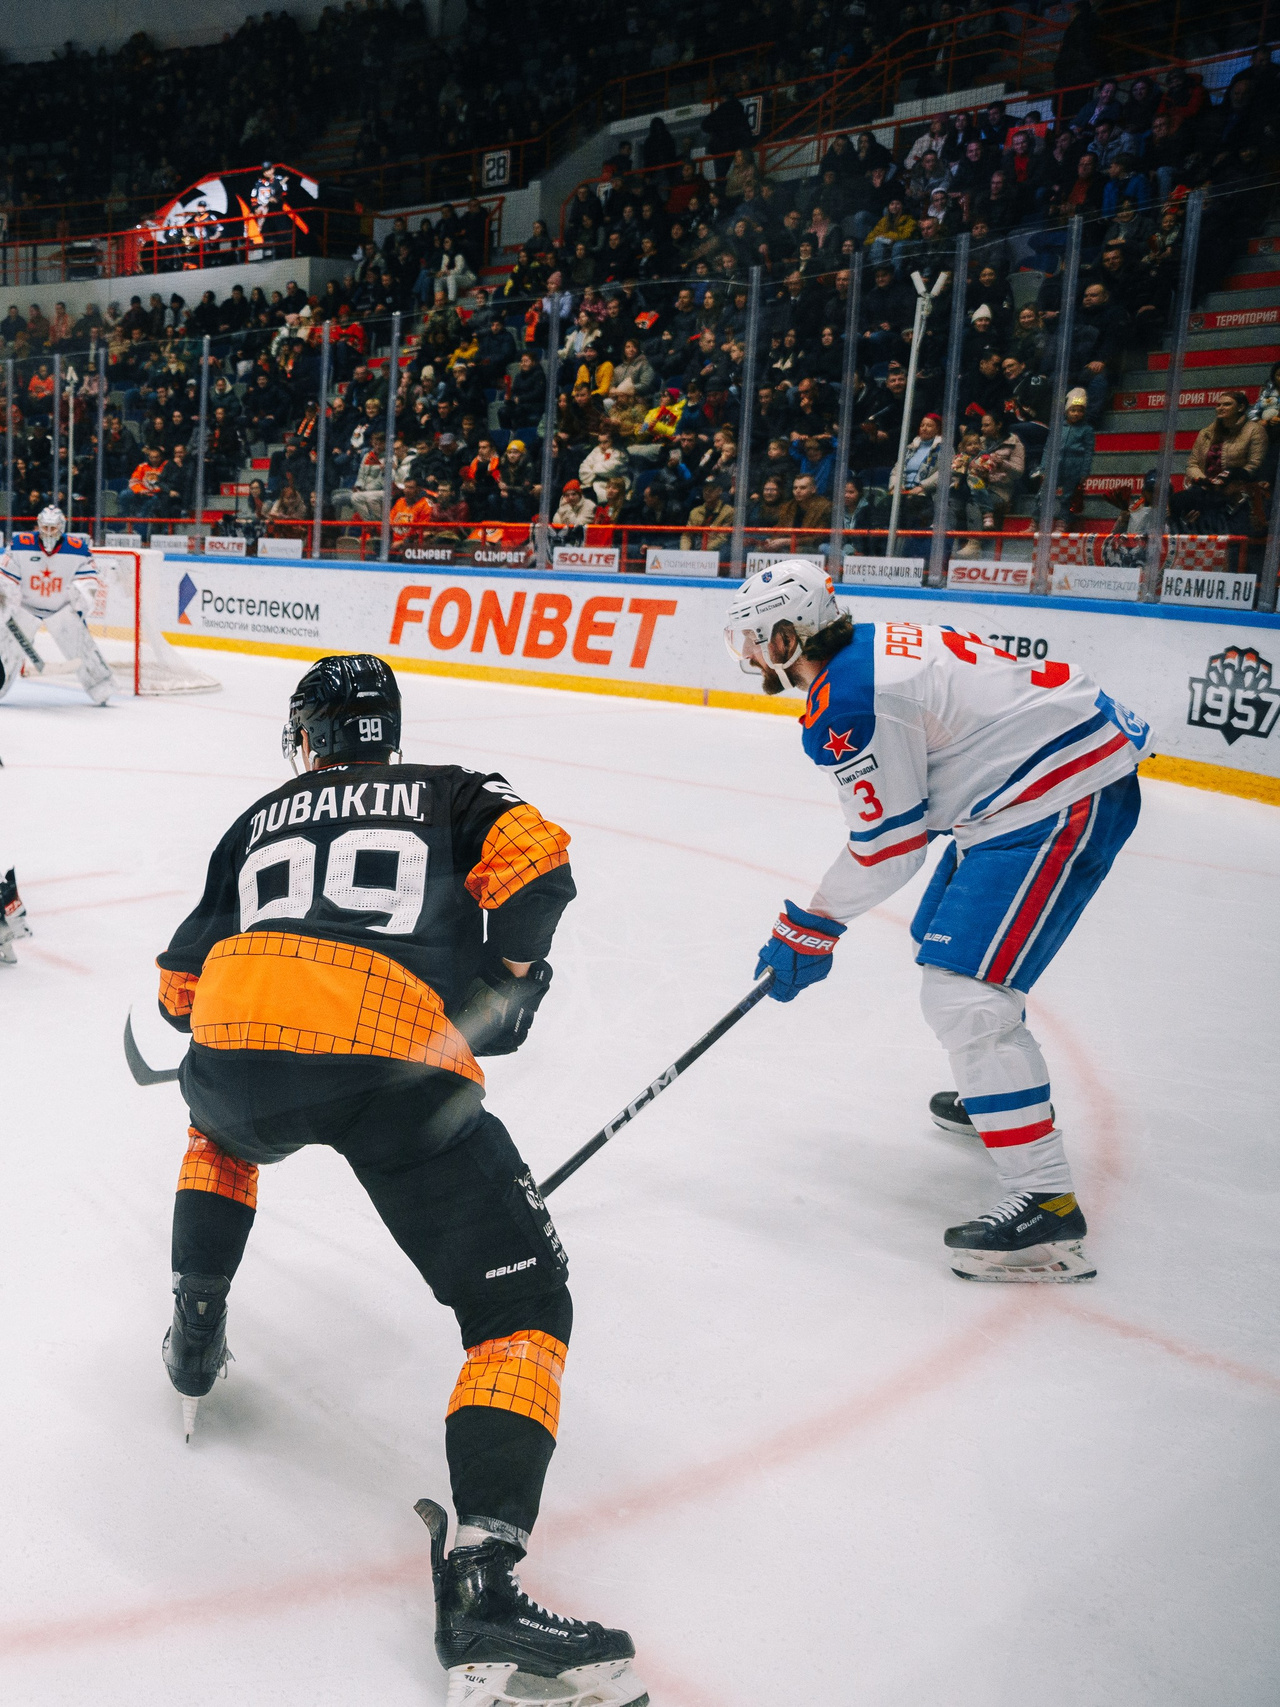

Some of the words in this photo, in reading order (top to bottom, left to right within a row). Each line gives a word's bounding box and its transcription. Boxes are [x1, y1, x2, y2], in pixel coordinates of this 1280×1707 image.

[486, 154, 506, 186] 28
[1216, 311, 1277, 327] ТЕРРИТОРИЯ
[209, 541, 244, 551] SOLITE
[404, 548, 452, 561] OLIMPBET
[474, 548, 527, 564] OLIMPBET
[557, 551, 617, 567] SOLITE
[844, 564, 924, 580] TICKETS.HCAMUR.RU
[952, 566, 1029, 585] SOLITE
[1163, 576, 1253, 602] HCAMUR.RU
[201, 589, 320, 621] Ростелеком
[201, 616, 249, 632] Технологии
[251, 623, 320, 638] возможностей
[388, 585, 678, 669] FONBET
[1191, 682, 1280, 733] 1957
[359, 718, 383, 742] 99
[853, 779, 884, 822] 3
[250, 782, 420, 843] DUBAKIN
[604, 1064, 678, 1140] CCM
[1016, 1213, 1043, 1233] BAUER
[485, 1257, 537, 1279] BAUER
[519, 1618, 569, 1638] BAUER
